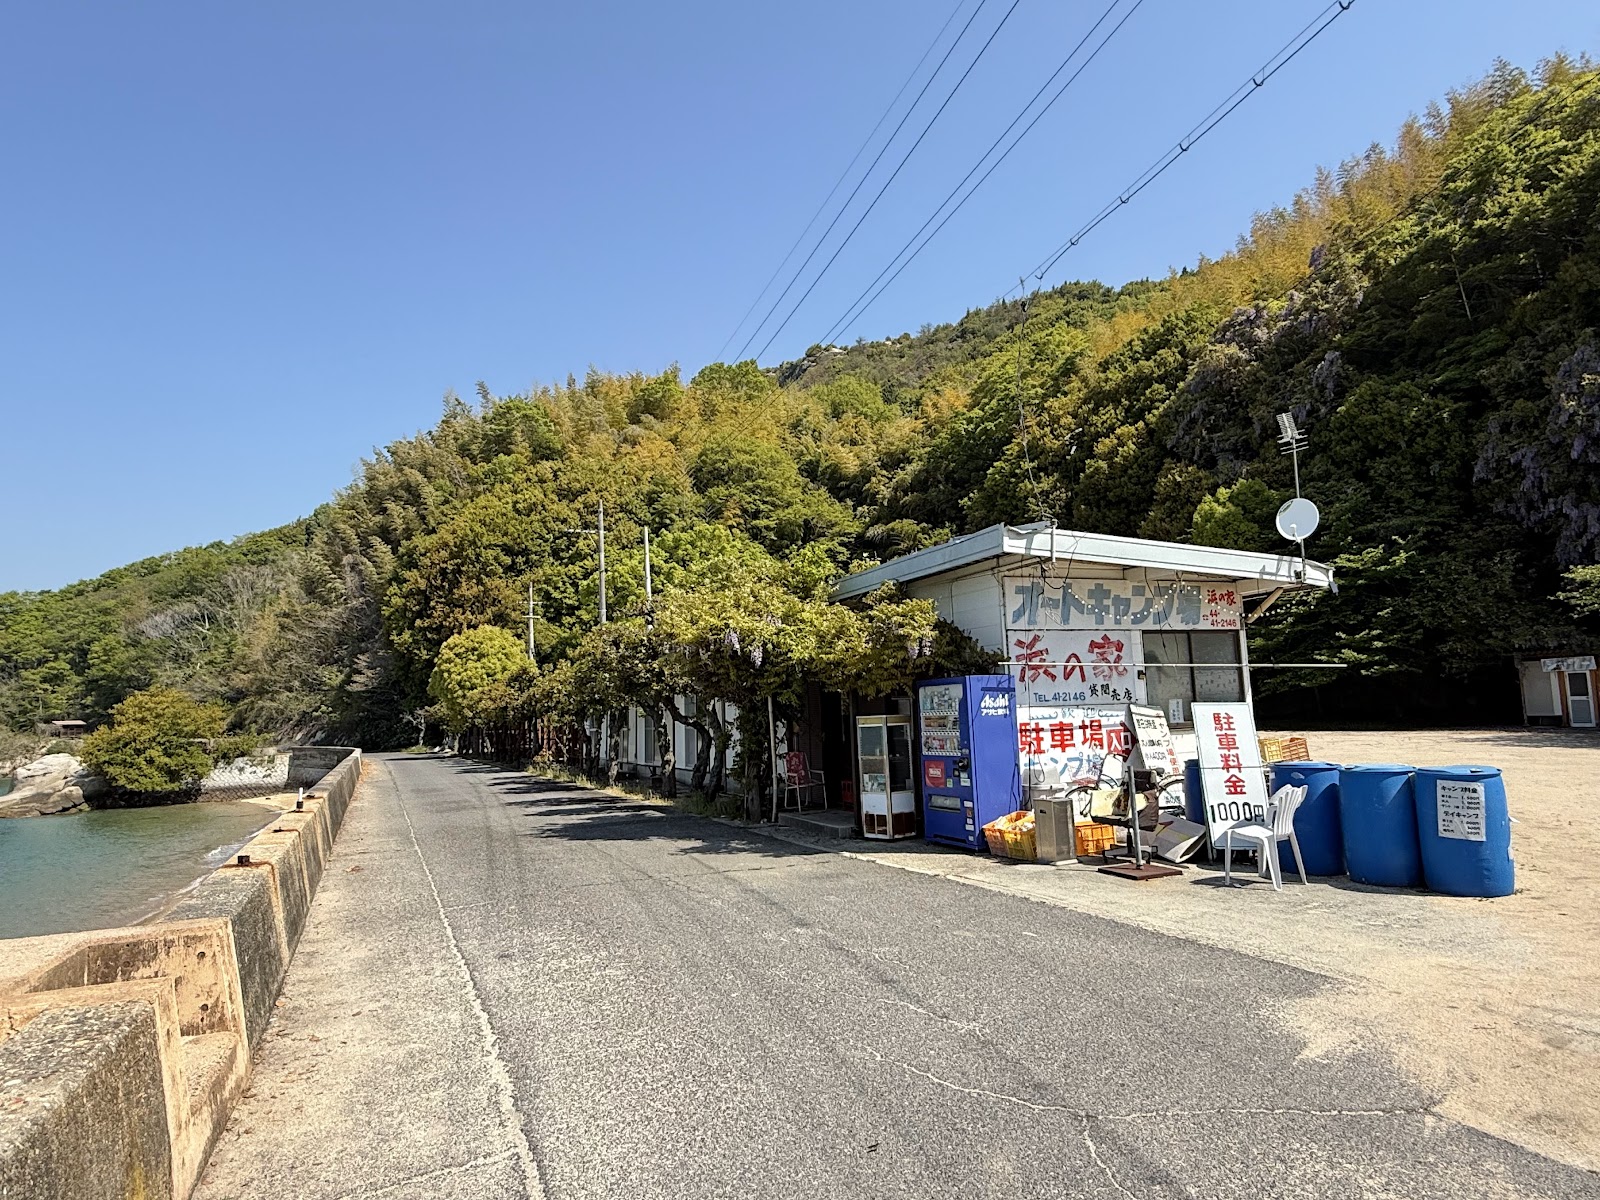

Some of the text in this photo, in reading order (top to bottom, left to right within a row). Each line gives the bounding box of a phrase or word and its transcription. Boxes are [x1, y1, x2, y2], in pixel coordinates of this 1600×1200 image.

[1012, 582, 1201, 625] オートキャンプ場
[1207, 589, 1236, 606] 浜の家
[1211, 619, 1237, 627] 41-2146
[1014, 634, 1128, 682] 浜の家
[981, 694, 1009, 708] Asahi
[1052, 692, 1086, 702] 41-2146
[1019, 719, 1103, 754] 駐車場
[1213, 712, 1246, 795] 駐車料金
[1210, 801, 1265, 823] 1000円
